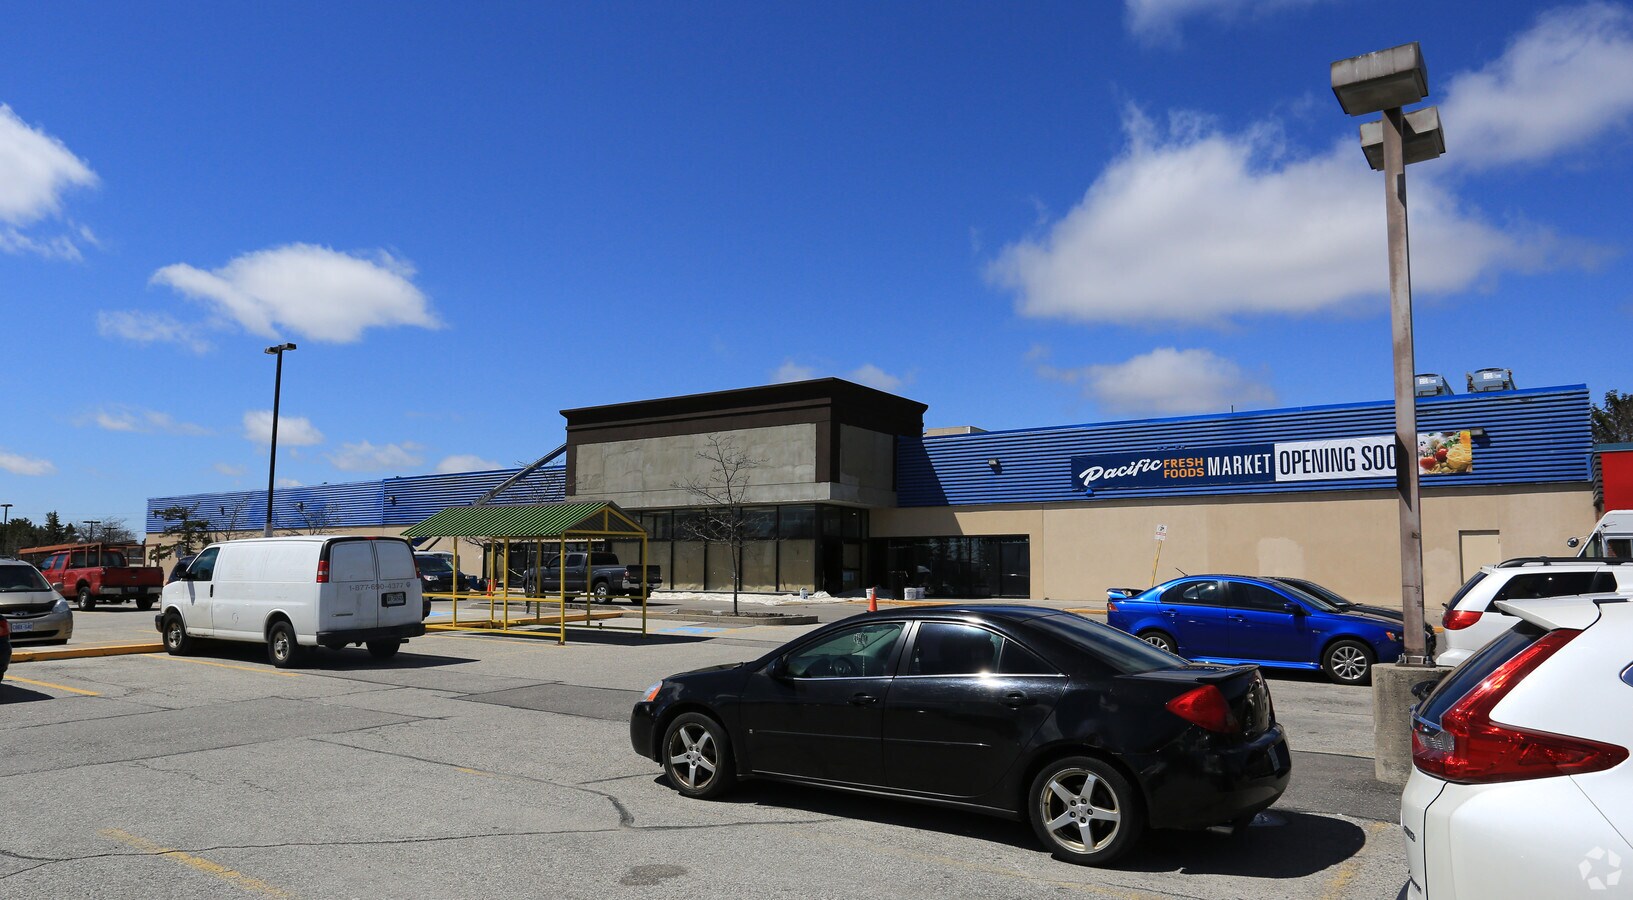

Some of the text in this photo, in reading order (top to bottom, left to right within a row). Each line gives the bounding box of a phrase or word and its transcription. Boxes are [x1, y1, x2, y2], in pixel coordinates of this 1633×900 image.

[1163, 457, 1204, 469] FRESH
[1207, 453, 1271, 477] MARKET
[1279, 443, 1397, 475] OPENING SOO
[1078, 458, 1163, 487] Pacific
[1163, 467, 1205, 479] FOODS
